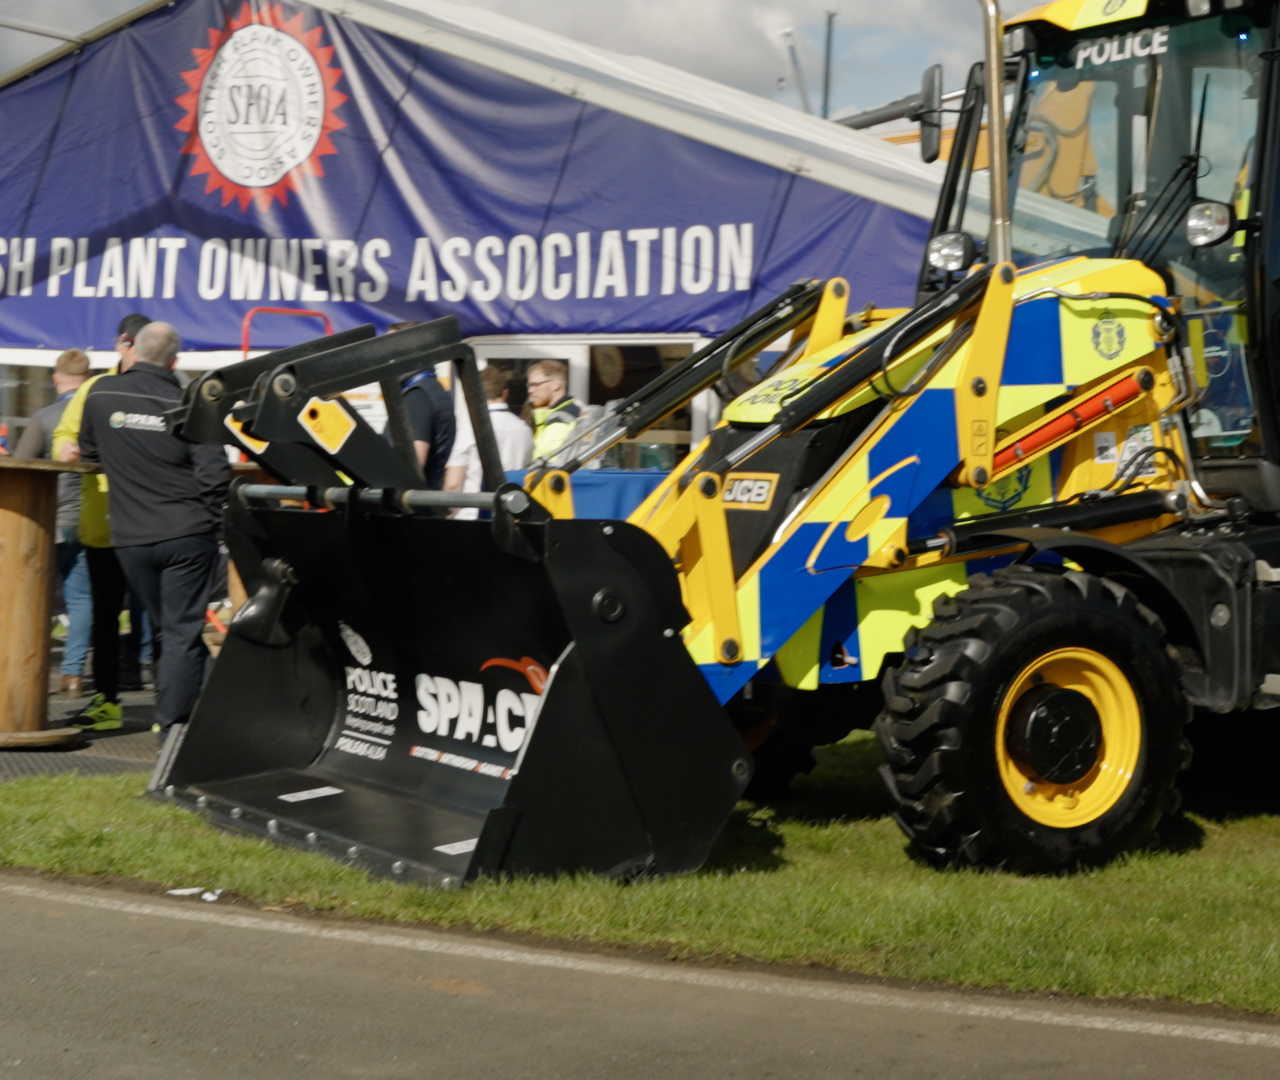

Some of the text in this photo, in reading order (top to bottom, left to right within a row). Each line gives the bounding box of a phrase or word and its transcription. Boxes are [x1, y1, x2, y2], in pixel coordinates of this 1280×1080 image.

[1075, 25, 1169, 70] POLICE
[227, 83, 289, 126] SPOA
[47, 236, 187, 299] PLANT
[197, 236, 392, 302] OWNERS
[405, 222, 754, 303] ASSOCIATION
[724, 479, 770, 502] JCB
[344, 666, 399, 699] POLICE
[347, 693, 400, 721] SCOTLAND
